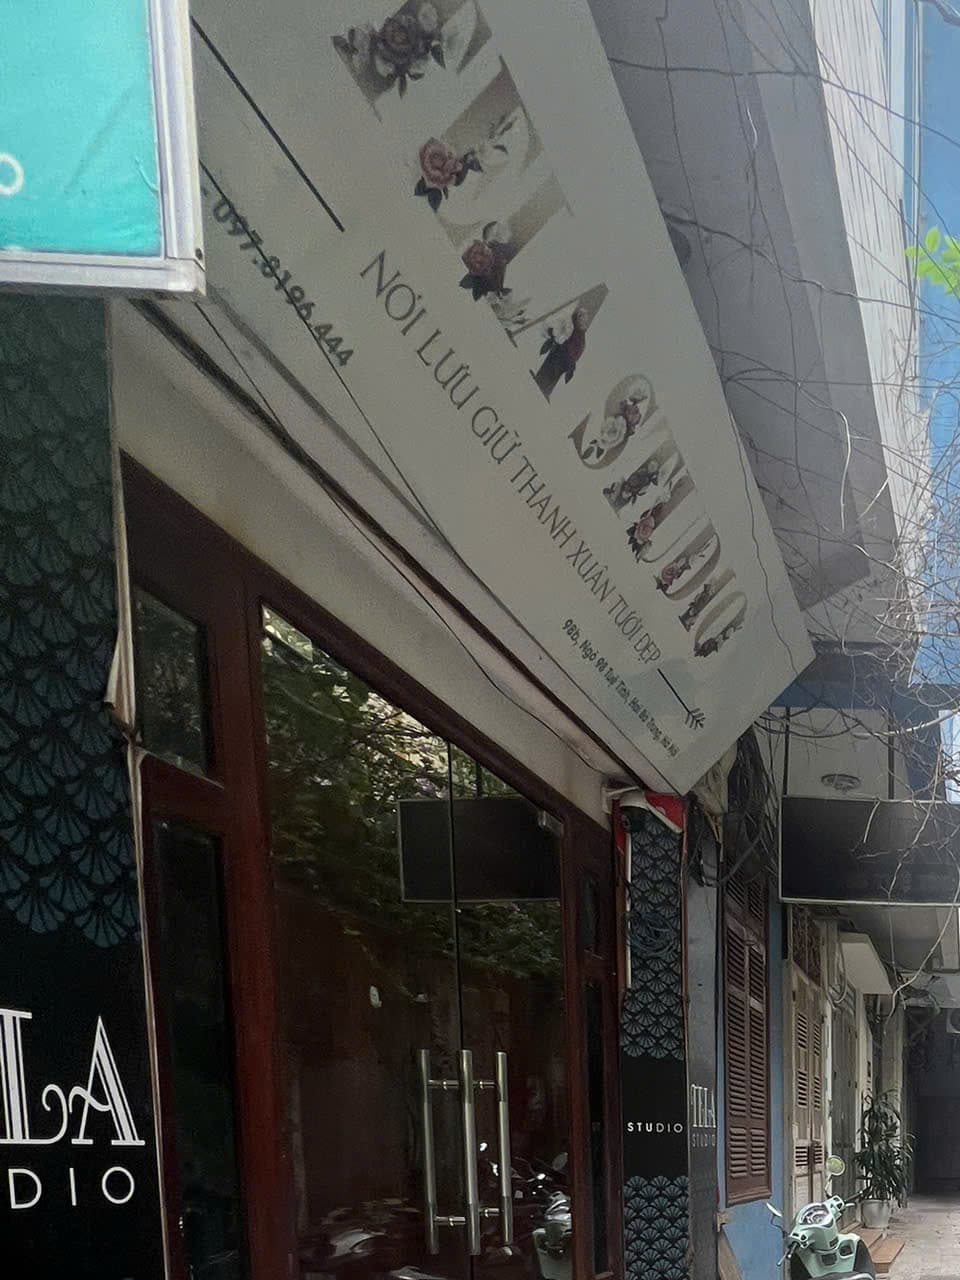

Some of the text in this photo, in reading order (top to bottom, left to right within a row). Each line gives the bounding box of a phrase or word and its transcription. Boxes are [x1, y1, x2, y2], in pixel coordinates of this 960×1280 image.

[360, 250, 427, 336] NƠI
[416, 328, 480, 410] LƯU
[510, 456, 577, 548] THANH
[566, 540, 616, 602] XUÂN
[608, 594, 643, 640] TƯƠI
[633, 632, 661, 664] ĐẸP
[568, 373, 748, 658] STUDIO
[8, 1166, 135, 1209] DIO
[627, 1122, 683, 1133] STUDIO
